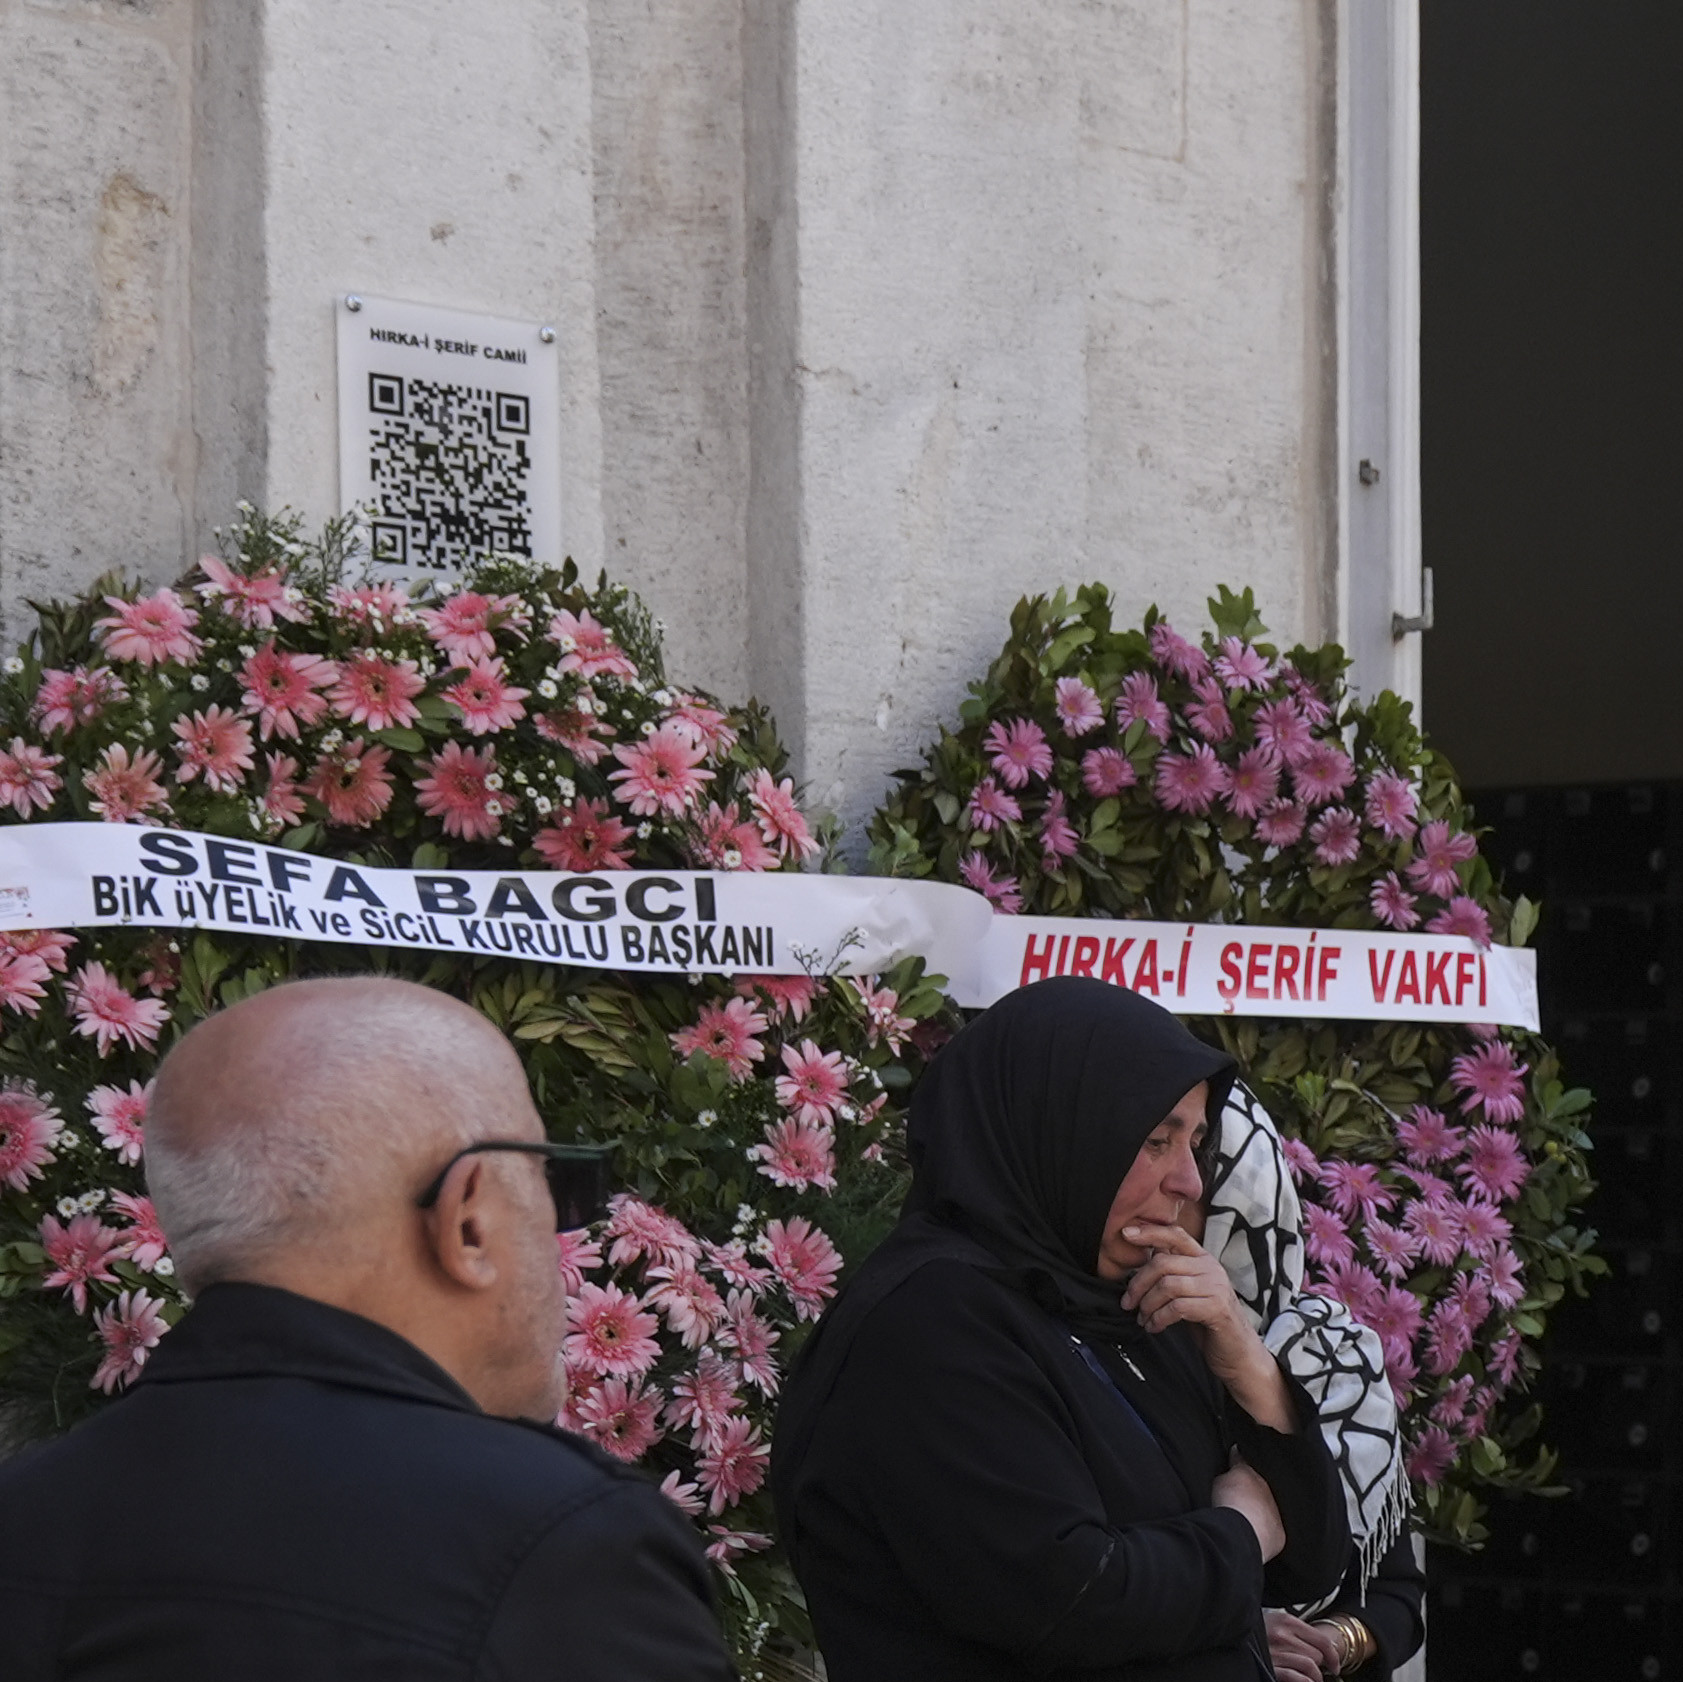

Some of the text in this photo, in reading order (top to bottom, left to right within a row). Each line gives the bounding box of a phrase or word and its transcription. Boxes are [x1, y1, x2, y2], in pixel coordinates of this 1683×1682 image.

[370, 327, 430, 349] HIRKA-İ
[434, 337, 478, 356] ŞERİF
[139, 832, 718, 922] SEFA BAGCI
[309, 908, 351, 937] ve
[459, 919, 610, 962] KURULU
[621, 925, 775, 970] BAŞKANI
[1217, 930, 1342, 1015] ŞERİF
